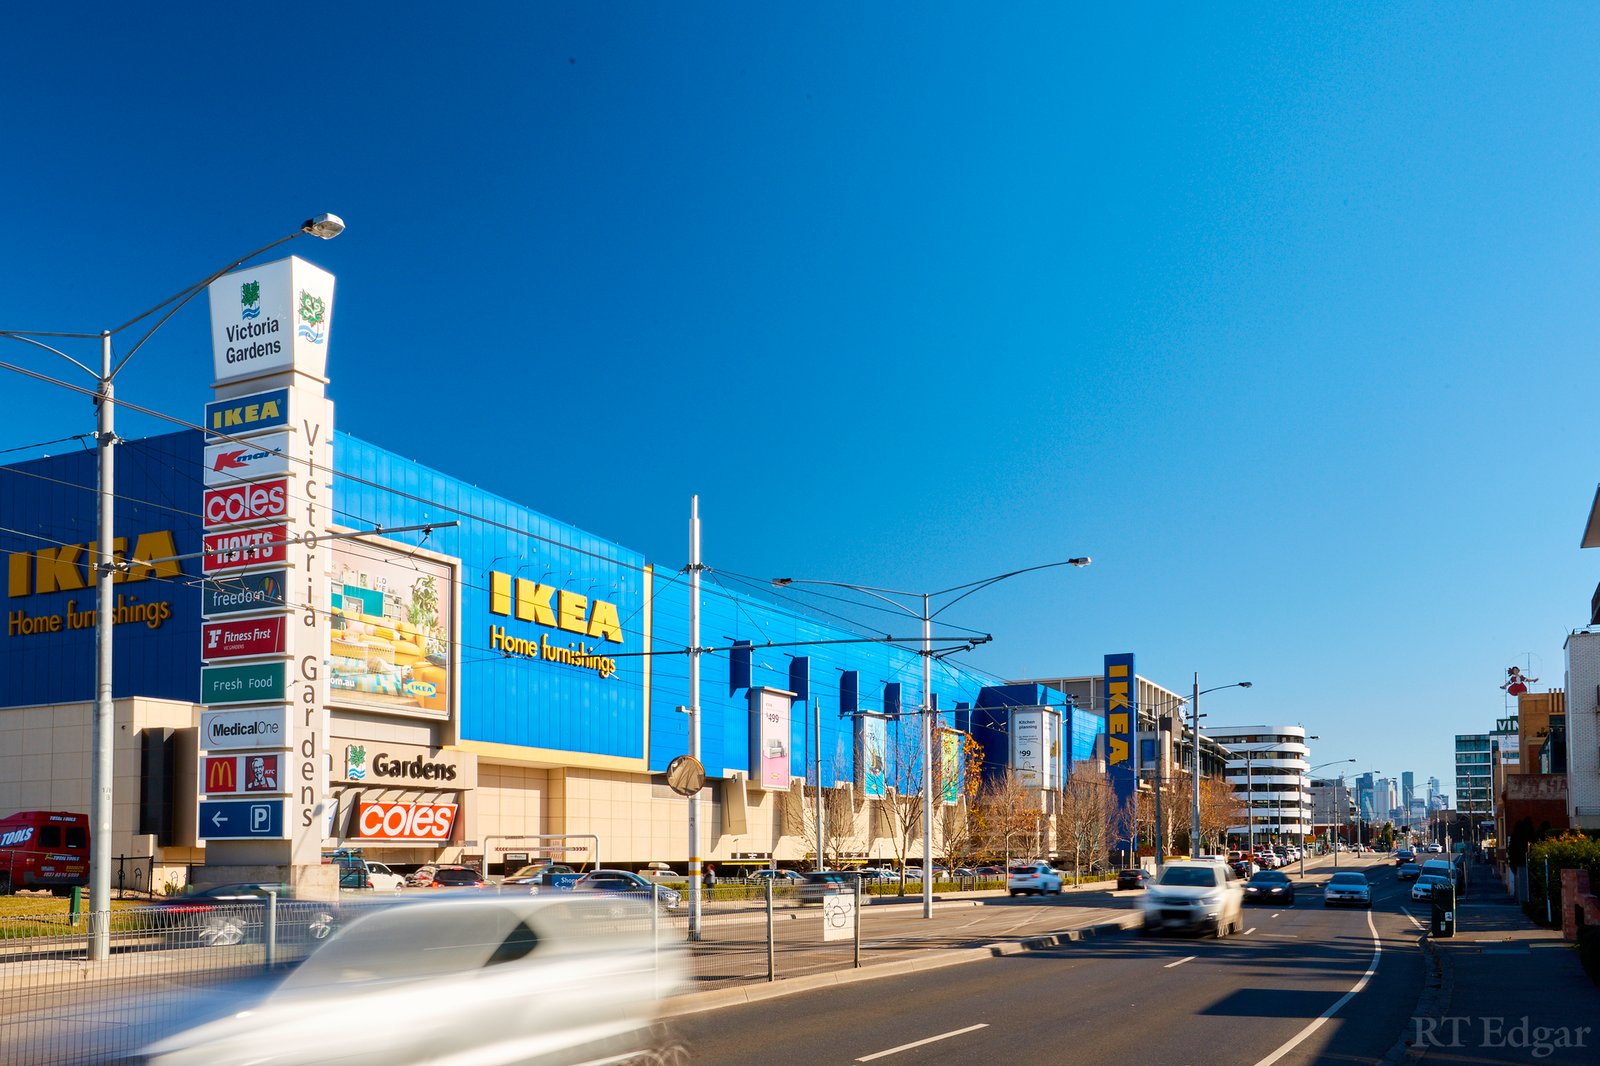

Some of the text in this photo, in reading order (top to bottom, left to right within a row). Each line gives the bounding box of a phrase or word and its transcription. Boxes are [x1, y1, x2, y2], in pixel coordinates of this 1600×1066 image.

[226, 317, 279, 342] Victoria
[226, 340, 281, 363] Gardens
[213, 400, 280, 429] IKEA
[213, 447, 281, 472] Kmart
[207, 486, 285, 523] coles
[303, 419, 319, 628] Victoria
[217, 531, 273, 564] HOYTS
[490, 570, 624, 643] IKEA
[9, 610, 62, 636] Home
[224, 628, 271, 644] Fitness First
[490, 624, 616, 678] Home furnishings
[213, 675, 273, 691] Fresh Food
[411, 684, 433, 693] IKEA
[213, 721, 279, 737] MedicalOne
[1108, 665, 1129, 766] IKEA
[301, 656, 317, 828] Gardens
[372, 752, 457, 781] Gardens
[254, 808, 268, 829] P
[360, 805, 452, 837] coles
[0, 827, 34, 847] TOOLS
